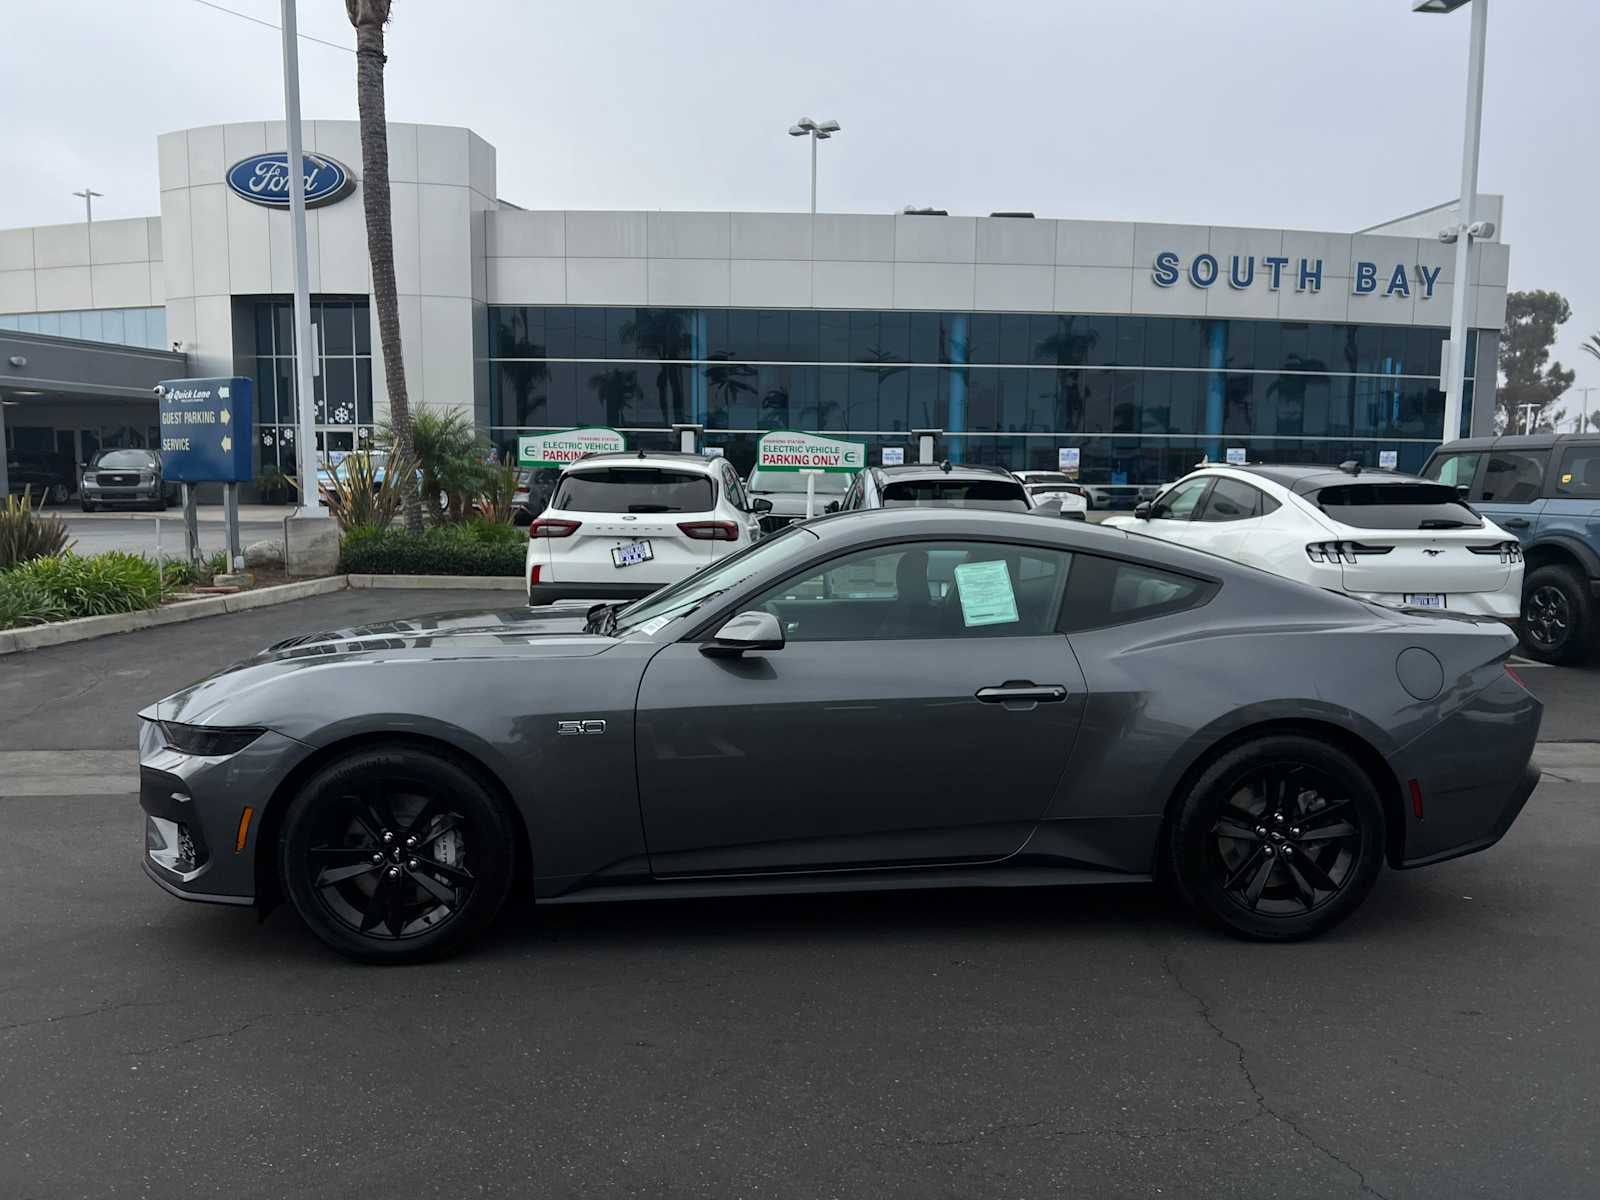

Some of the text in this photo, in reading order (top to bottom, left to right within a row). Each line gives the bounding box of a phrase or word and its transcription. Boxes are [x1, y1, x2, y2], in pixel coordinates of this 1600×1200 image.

[249, 161, 318, 192] Fod
[1152, 251, 1441, 299] SOUTH BAY
[174, 389, 211, 400] Quick Lane
[162, 411, 215, 424] GUEST PARKING
[163, 438, 190, 451] SERVICE
[543, 441, 619, 451] ELECTRIC VEHICLE
[763, 445, 840, 454] ELECTRIC VEHICLE
[543, 450, 588, 461] PARKIN
[763, 454, 840, 465] PARKING ONLY
[557, 720, 606, 735] 5.0
